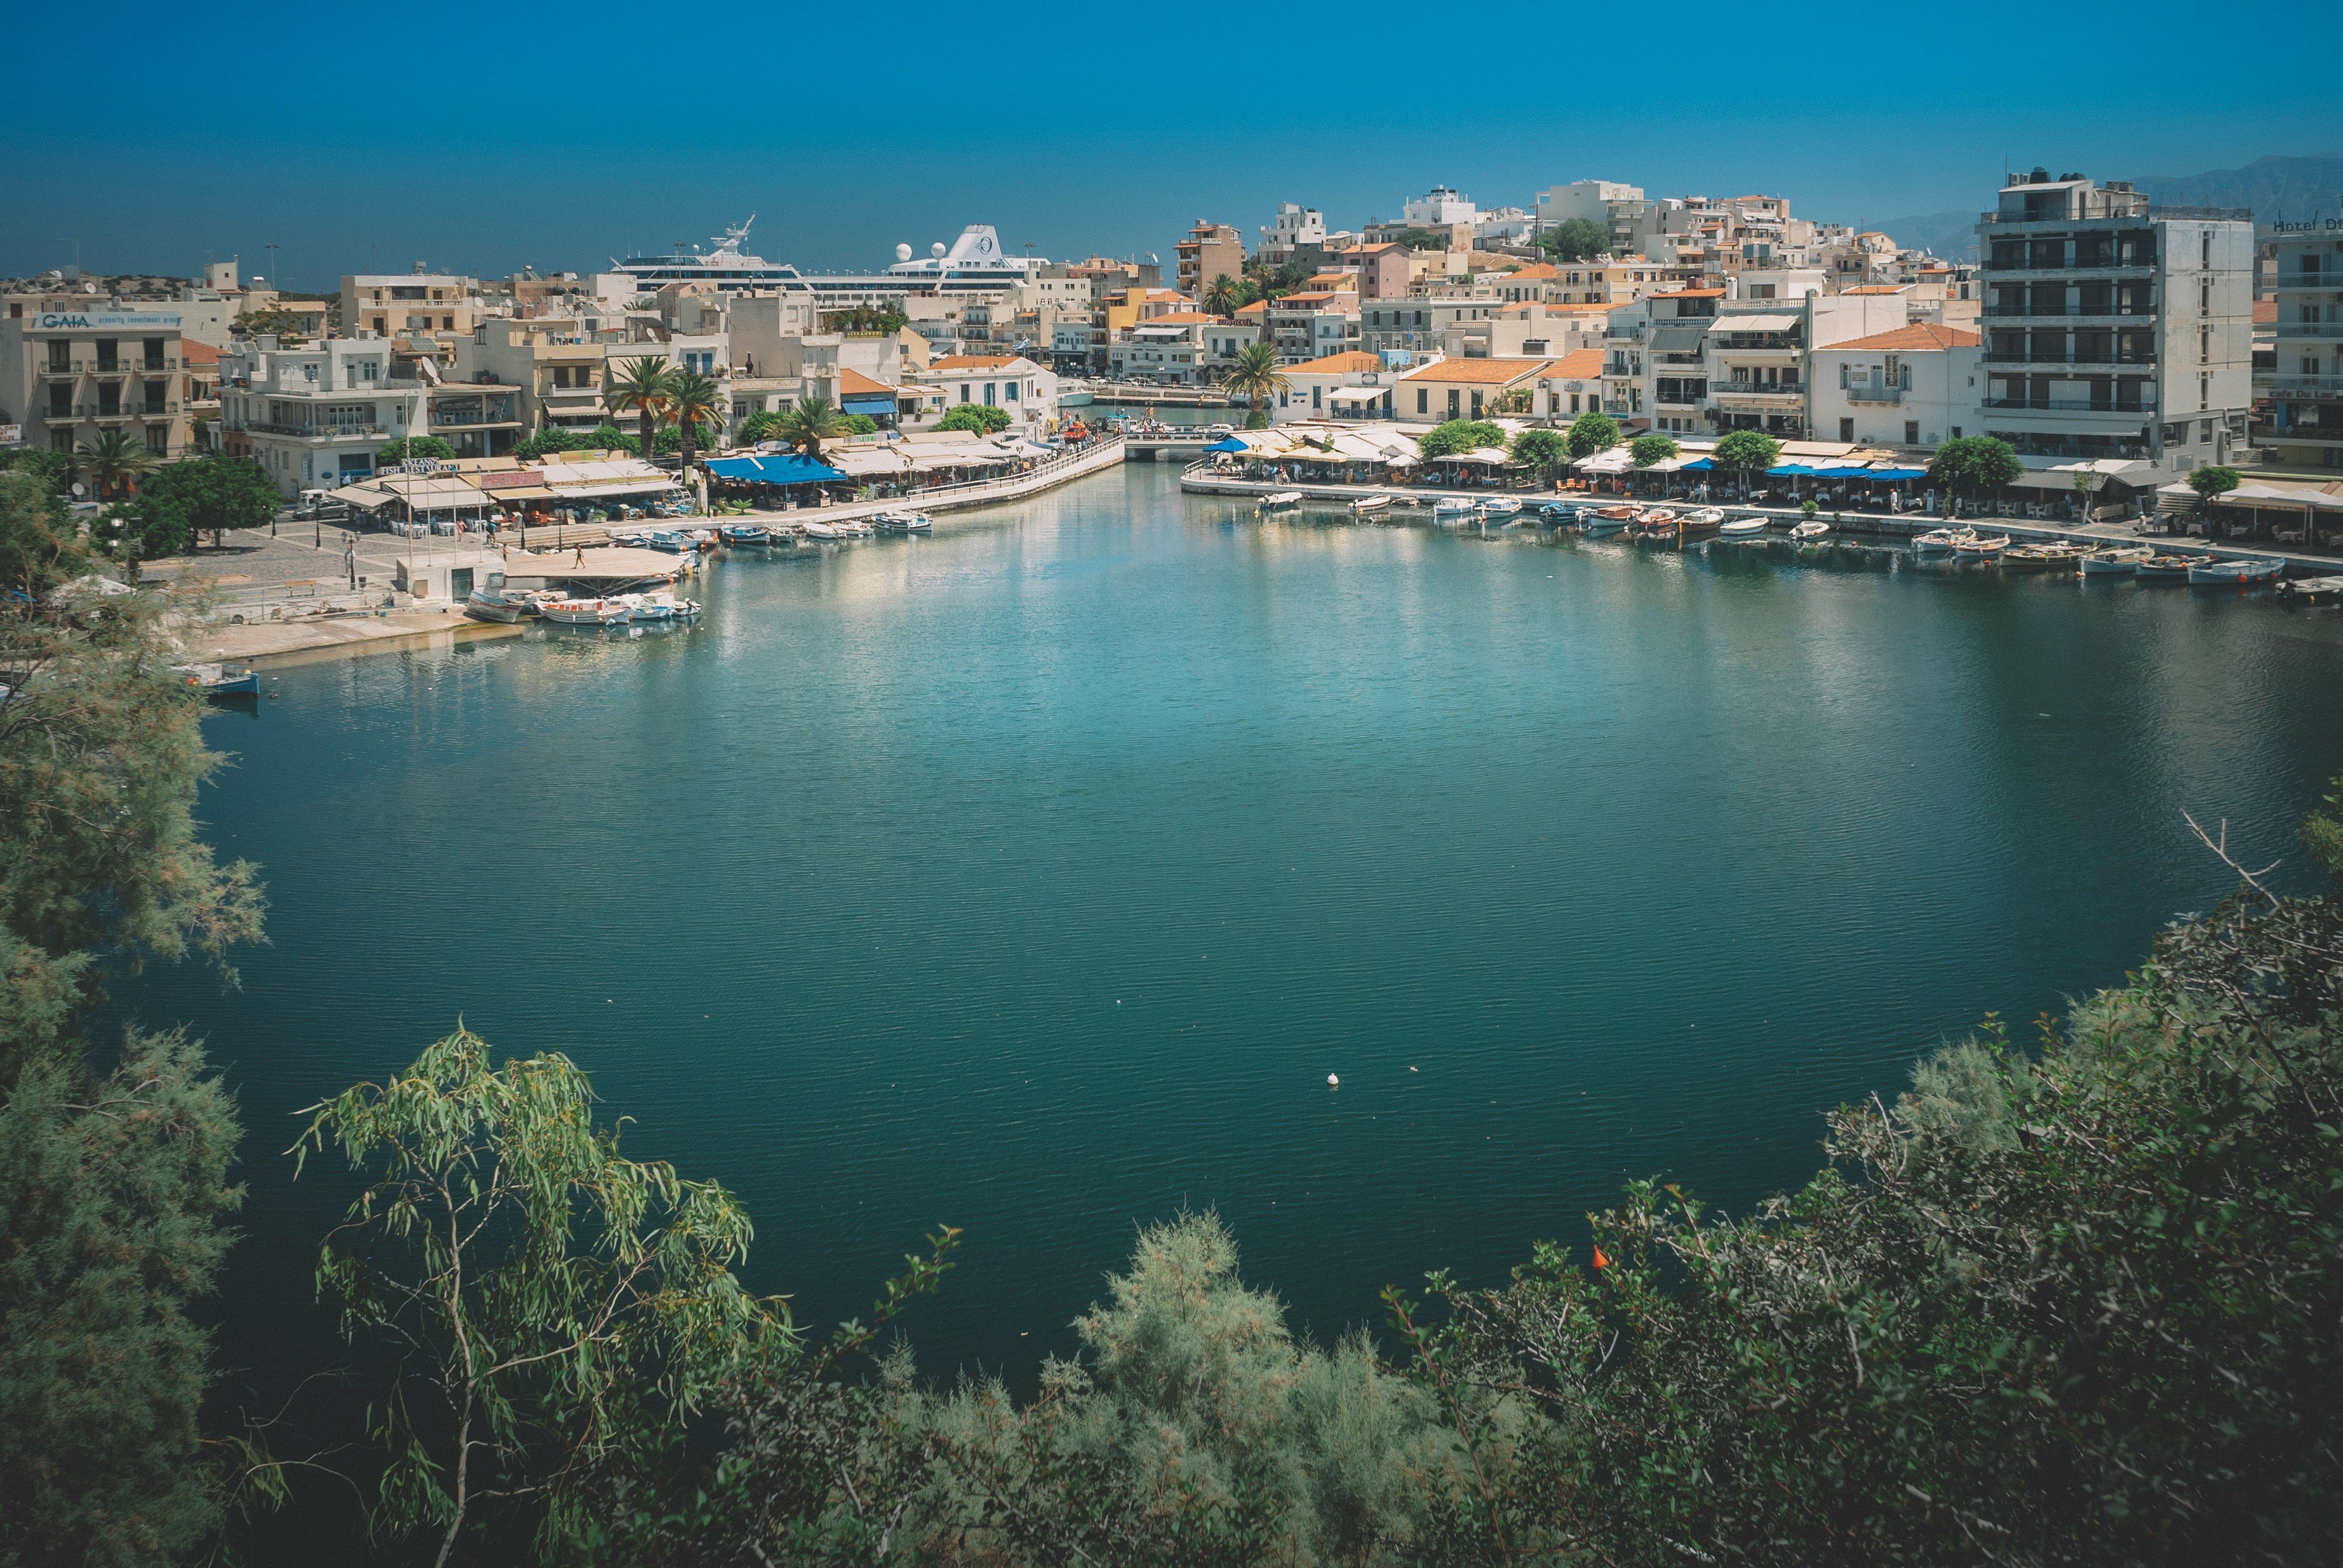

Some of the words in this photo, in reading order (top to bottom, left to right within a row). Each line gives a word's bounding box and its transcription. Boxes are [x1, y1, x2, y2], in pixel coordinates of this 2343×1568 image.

[2274, 219, 2316, 232] Hotel
[43, 314, 90, 328] GAIA
[2296, 390, 2311, 398] Du
[2314, 390, 2333, 398] Lac
[382, 467, 400, 475] FISH
